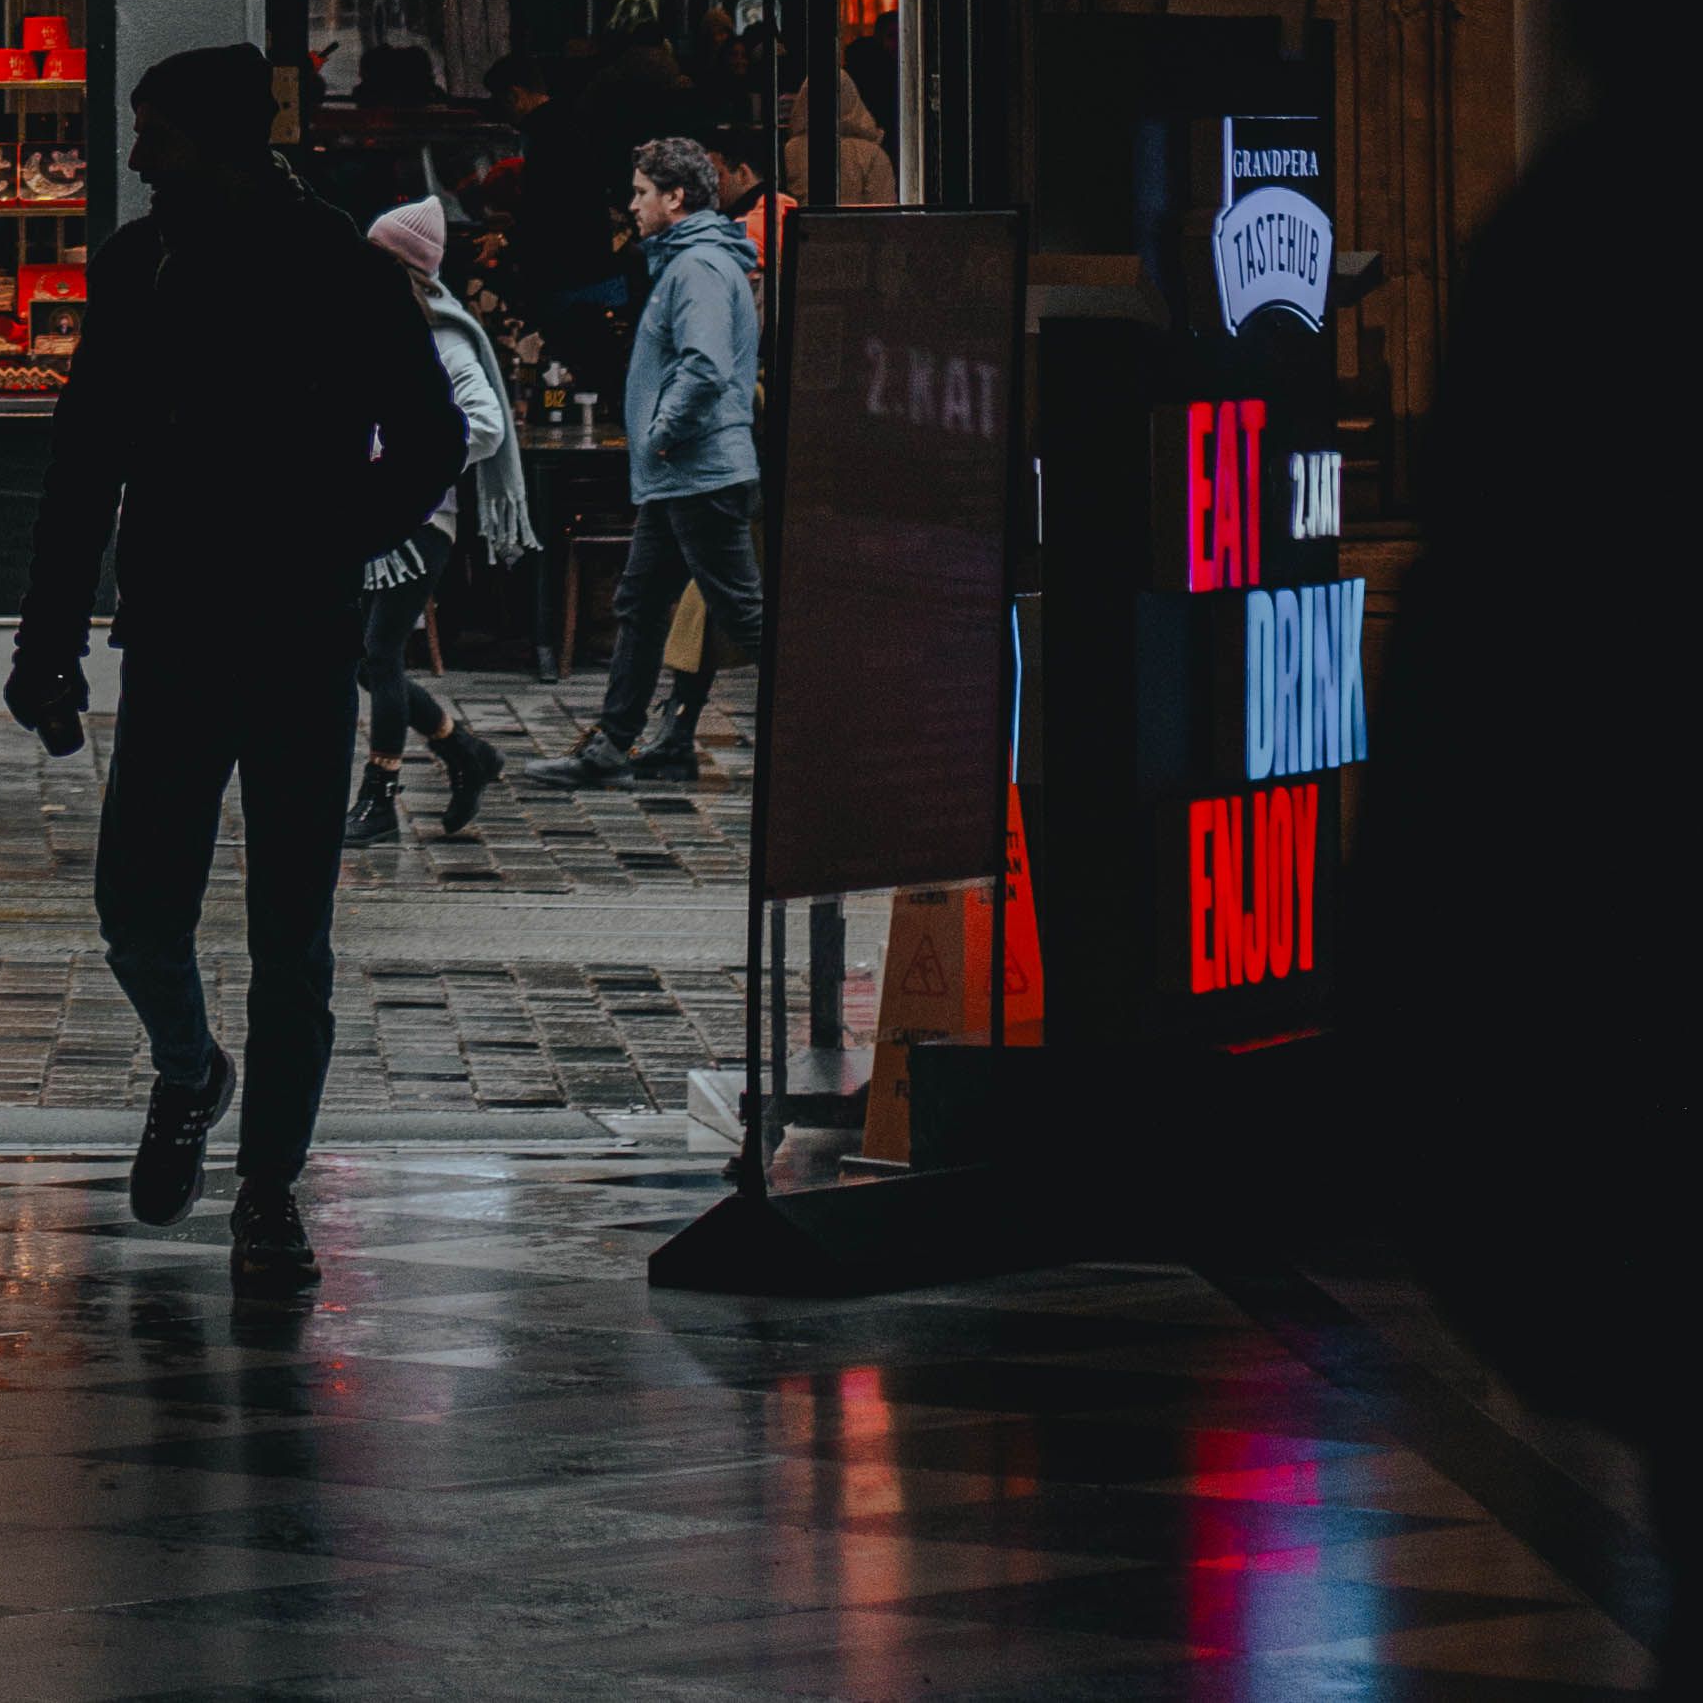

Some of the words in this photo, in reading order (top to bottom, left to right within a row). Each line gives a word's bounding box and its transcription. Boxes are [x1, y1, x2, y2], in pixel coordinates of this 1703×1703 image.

[1233, 148, 1321, 179] GRANDPERA
[1233, 212, 1321, 290] TASTEHUB
[1187, 397, 1268, 594] EAT
[1245, 577, 1369, 783] DRINK
[1188, 781, 1320, 994] ENJOY
